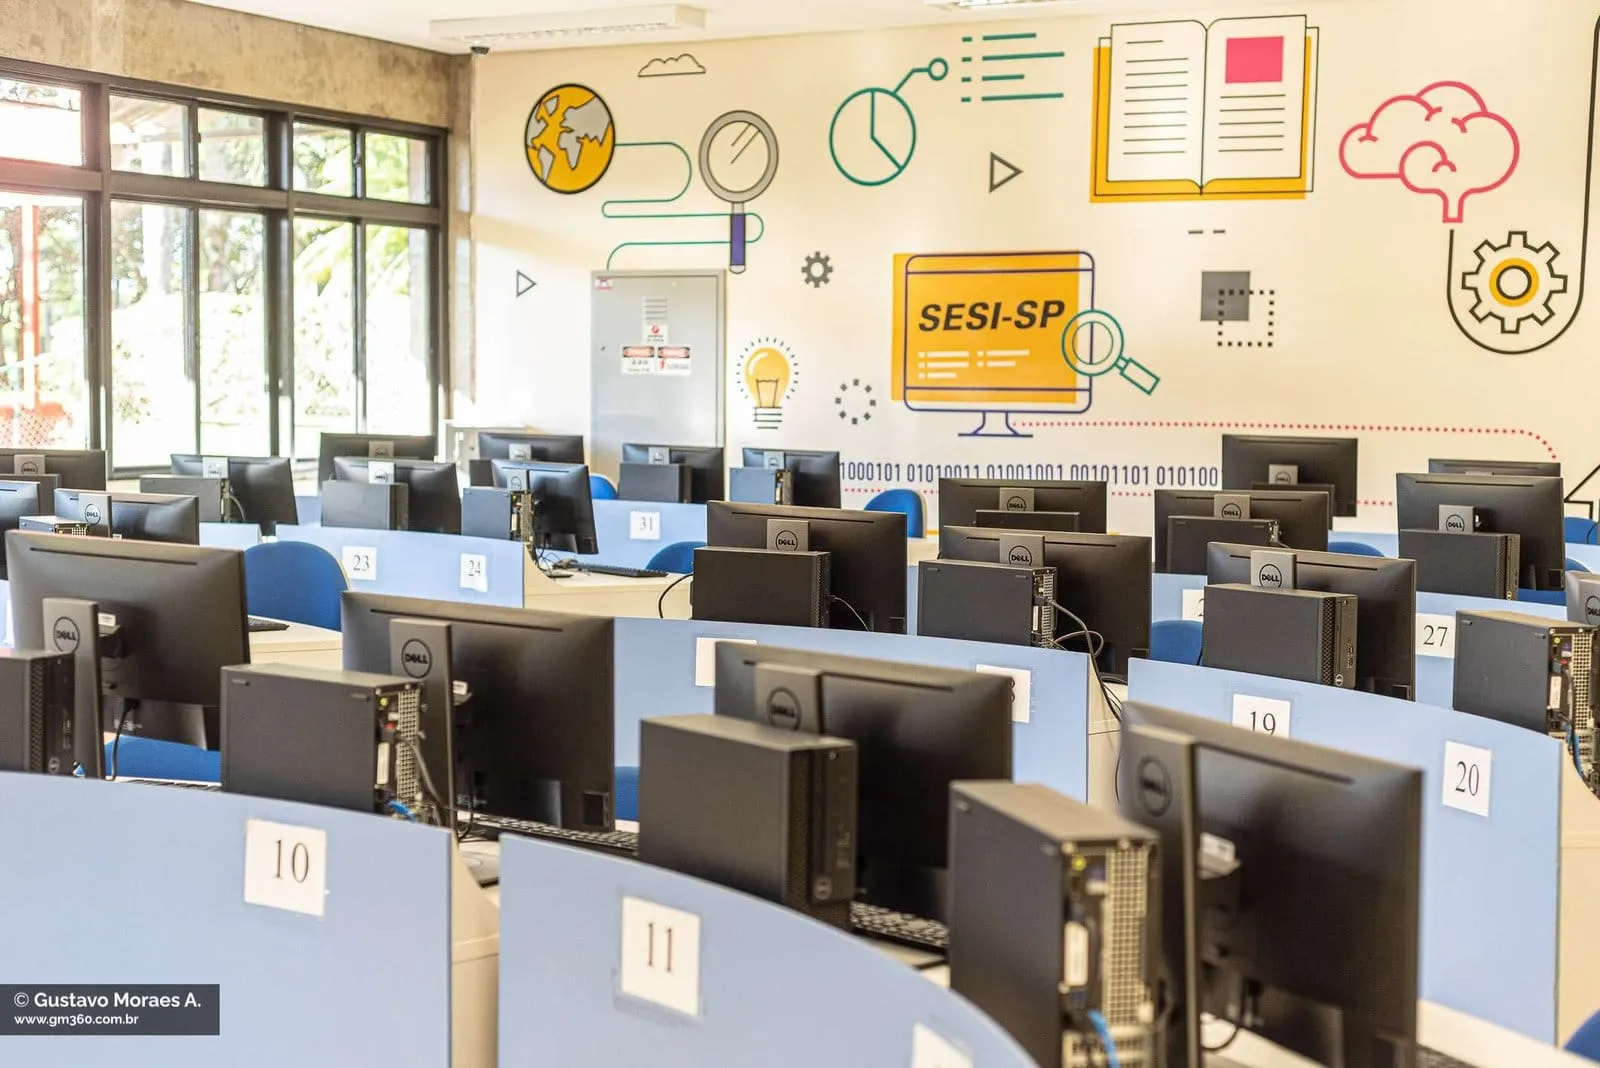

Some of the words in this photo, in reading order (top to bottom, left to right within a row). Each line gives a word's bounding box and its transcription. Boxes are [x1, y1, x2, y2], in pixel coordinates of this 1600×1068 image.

[918, 299, 1066, 332] SESI-SP
[907, 463, 980, 483] 01010011
[1070, 465, 1149, 485] 00101101
[639, 517, 653, 531] 31
[353, 554, 370, 571] 23
[469, 560, 481, 577] 24
[1261, 575, 1280, 583] DELL
[56, 630, 76, 641] DELL
[1424, 624, 1448, 647] 27
[404, 653, 428, 664] DELL
[1250, 711, 1276, 736] 19
[1455, 760, 1480, 796] 20
[273, 839, 309, 883] 10
[647, 922, 673, 973] 11
